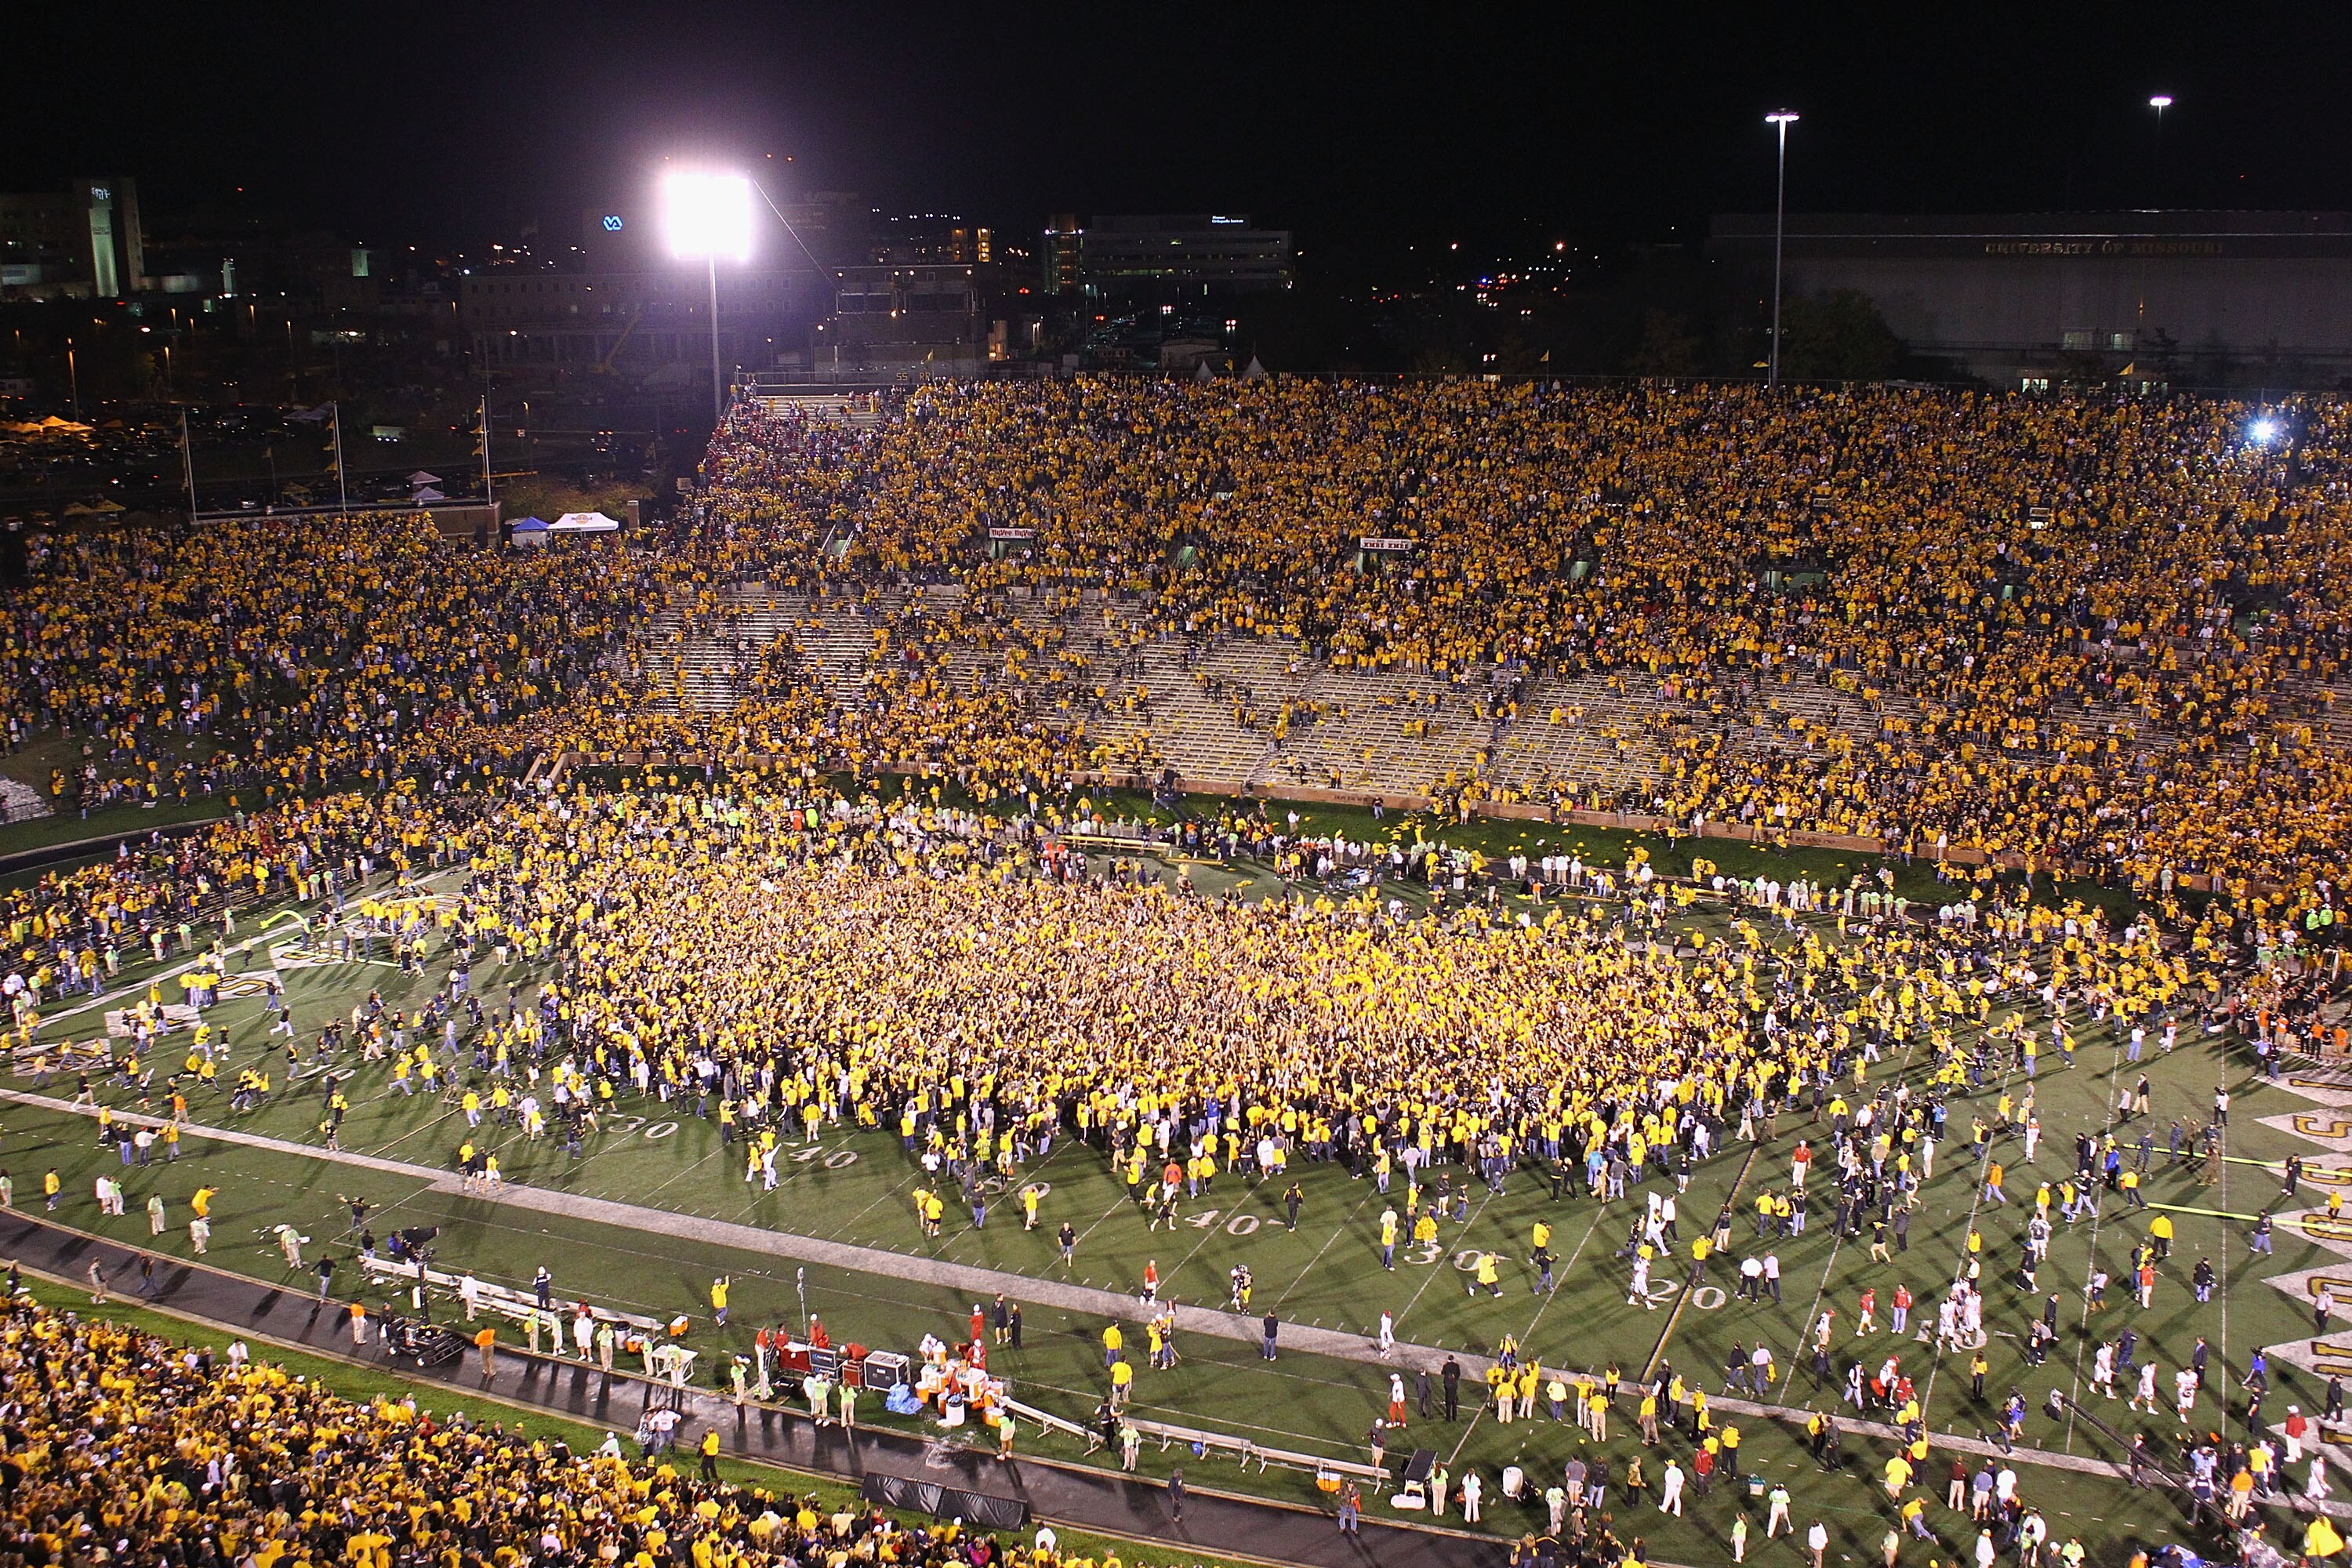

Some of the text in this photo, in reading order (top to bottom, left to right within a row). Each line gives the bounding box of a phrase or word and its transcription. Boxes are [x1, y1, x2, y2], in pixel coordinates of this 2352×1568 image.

[603, 216, 622, 230] VA
[1985, 241, 2223, 254] UNIVERSITY OF MISSOURI
[896, 372, 908, 381] SS
[1640, 377, 1653, 387] KK
[1662, 378, 1675, 387] JJ
[2087, 387, 2102, 397] FF
[607, 1116, 680, 1139] 30
[789, 1145, 859, 1170] 40
[1185, 1209, 1261, 1236] 40
[1403, 1243, 1484, 1272] 30
[1648, 1278, 1727, 1310] 20
